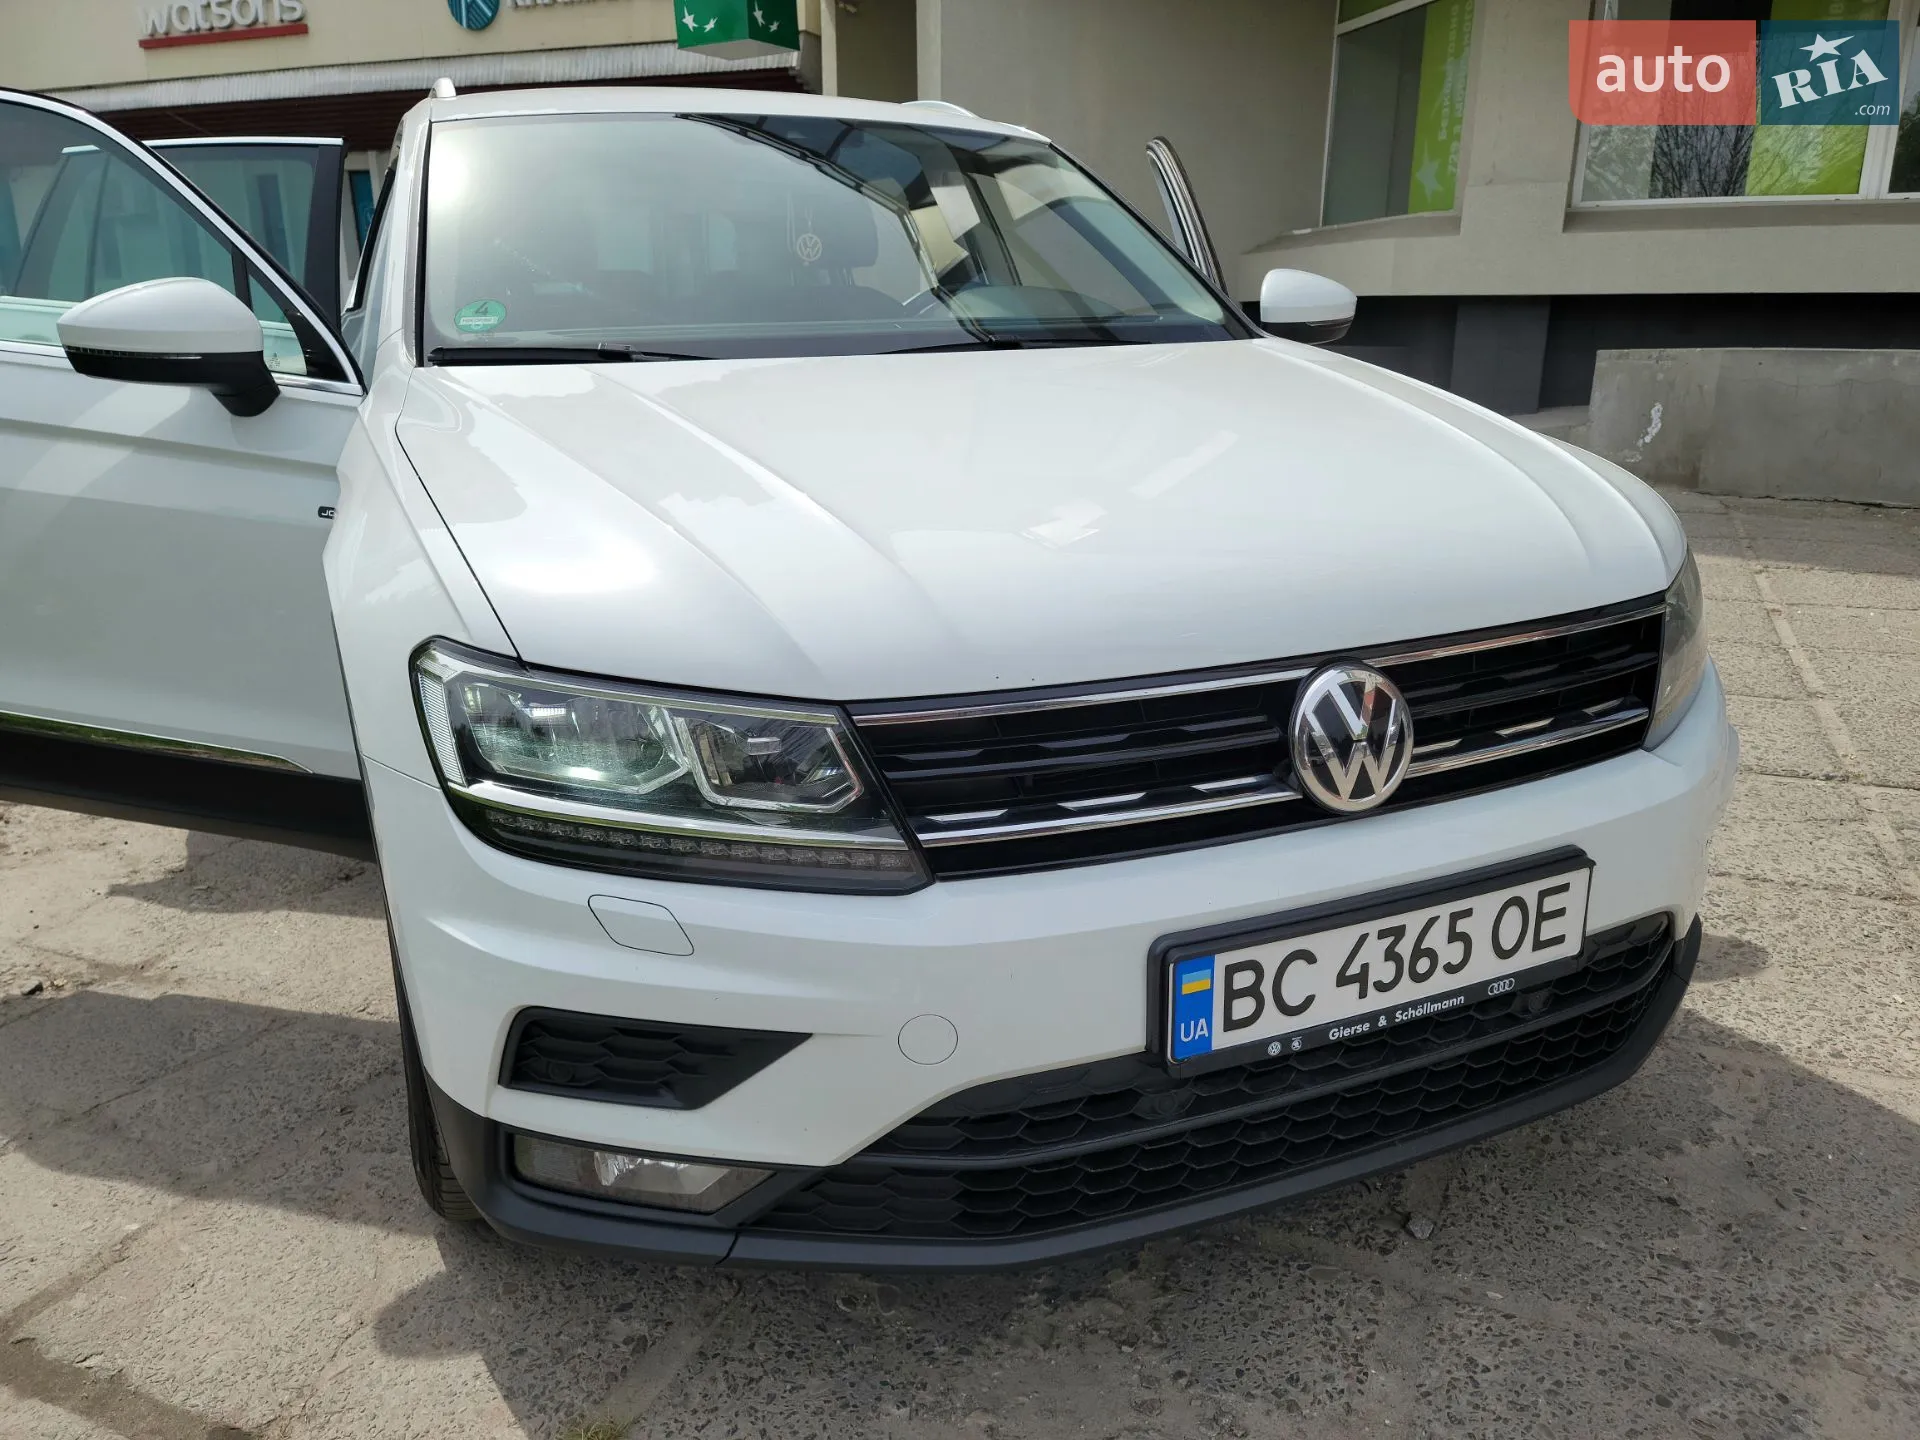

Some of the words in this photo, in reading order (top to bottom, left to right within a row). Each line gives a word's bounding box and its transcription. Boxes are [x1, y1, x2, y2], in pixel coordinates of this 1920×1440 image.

[475, 302, 489, 316] 4
[1223, 949, 1317, 1033] BC
[1335, 907, 1473, 999] 4365
[1491, 882, 1571, 960] OE
[1180, 1018, 1209, 1044] UA
[1329, 1022, 1370, 1041] Gierse
[1378, 1015, 1387, 1027] &
[1395, 995, 1465, 1023] Schöllmann
